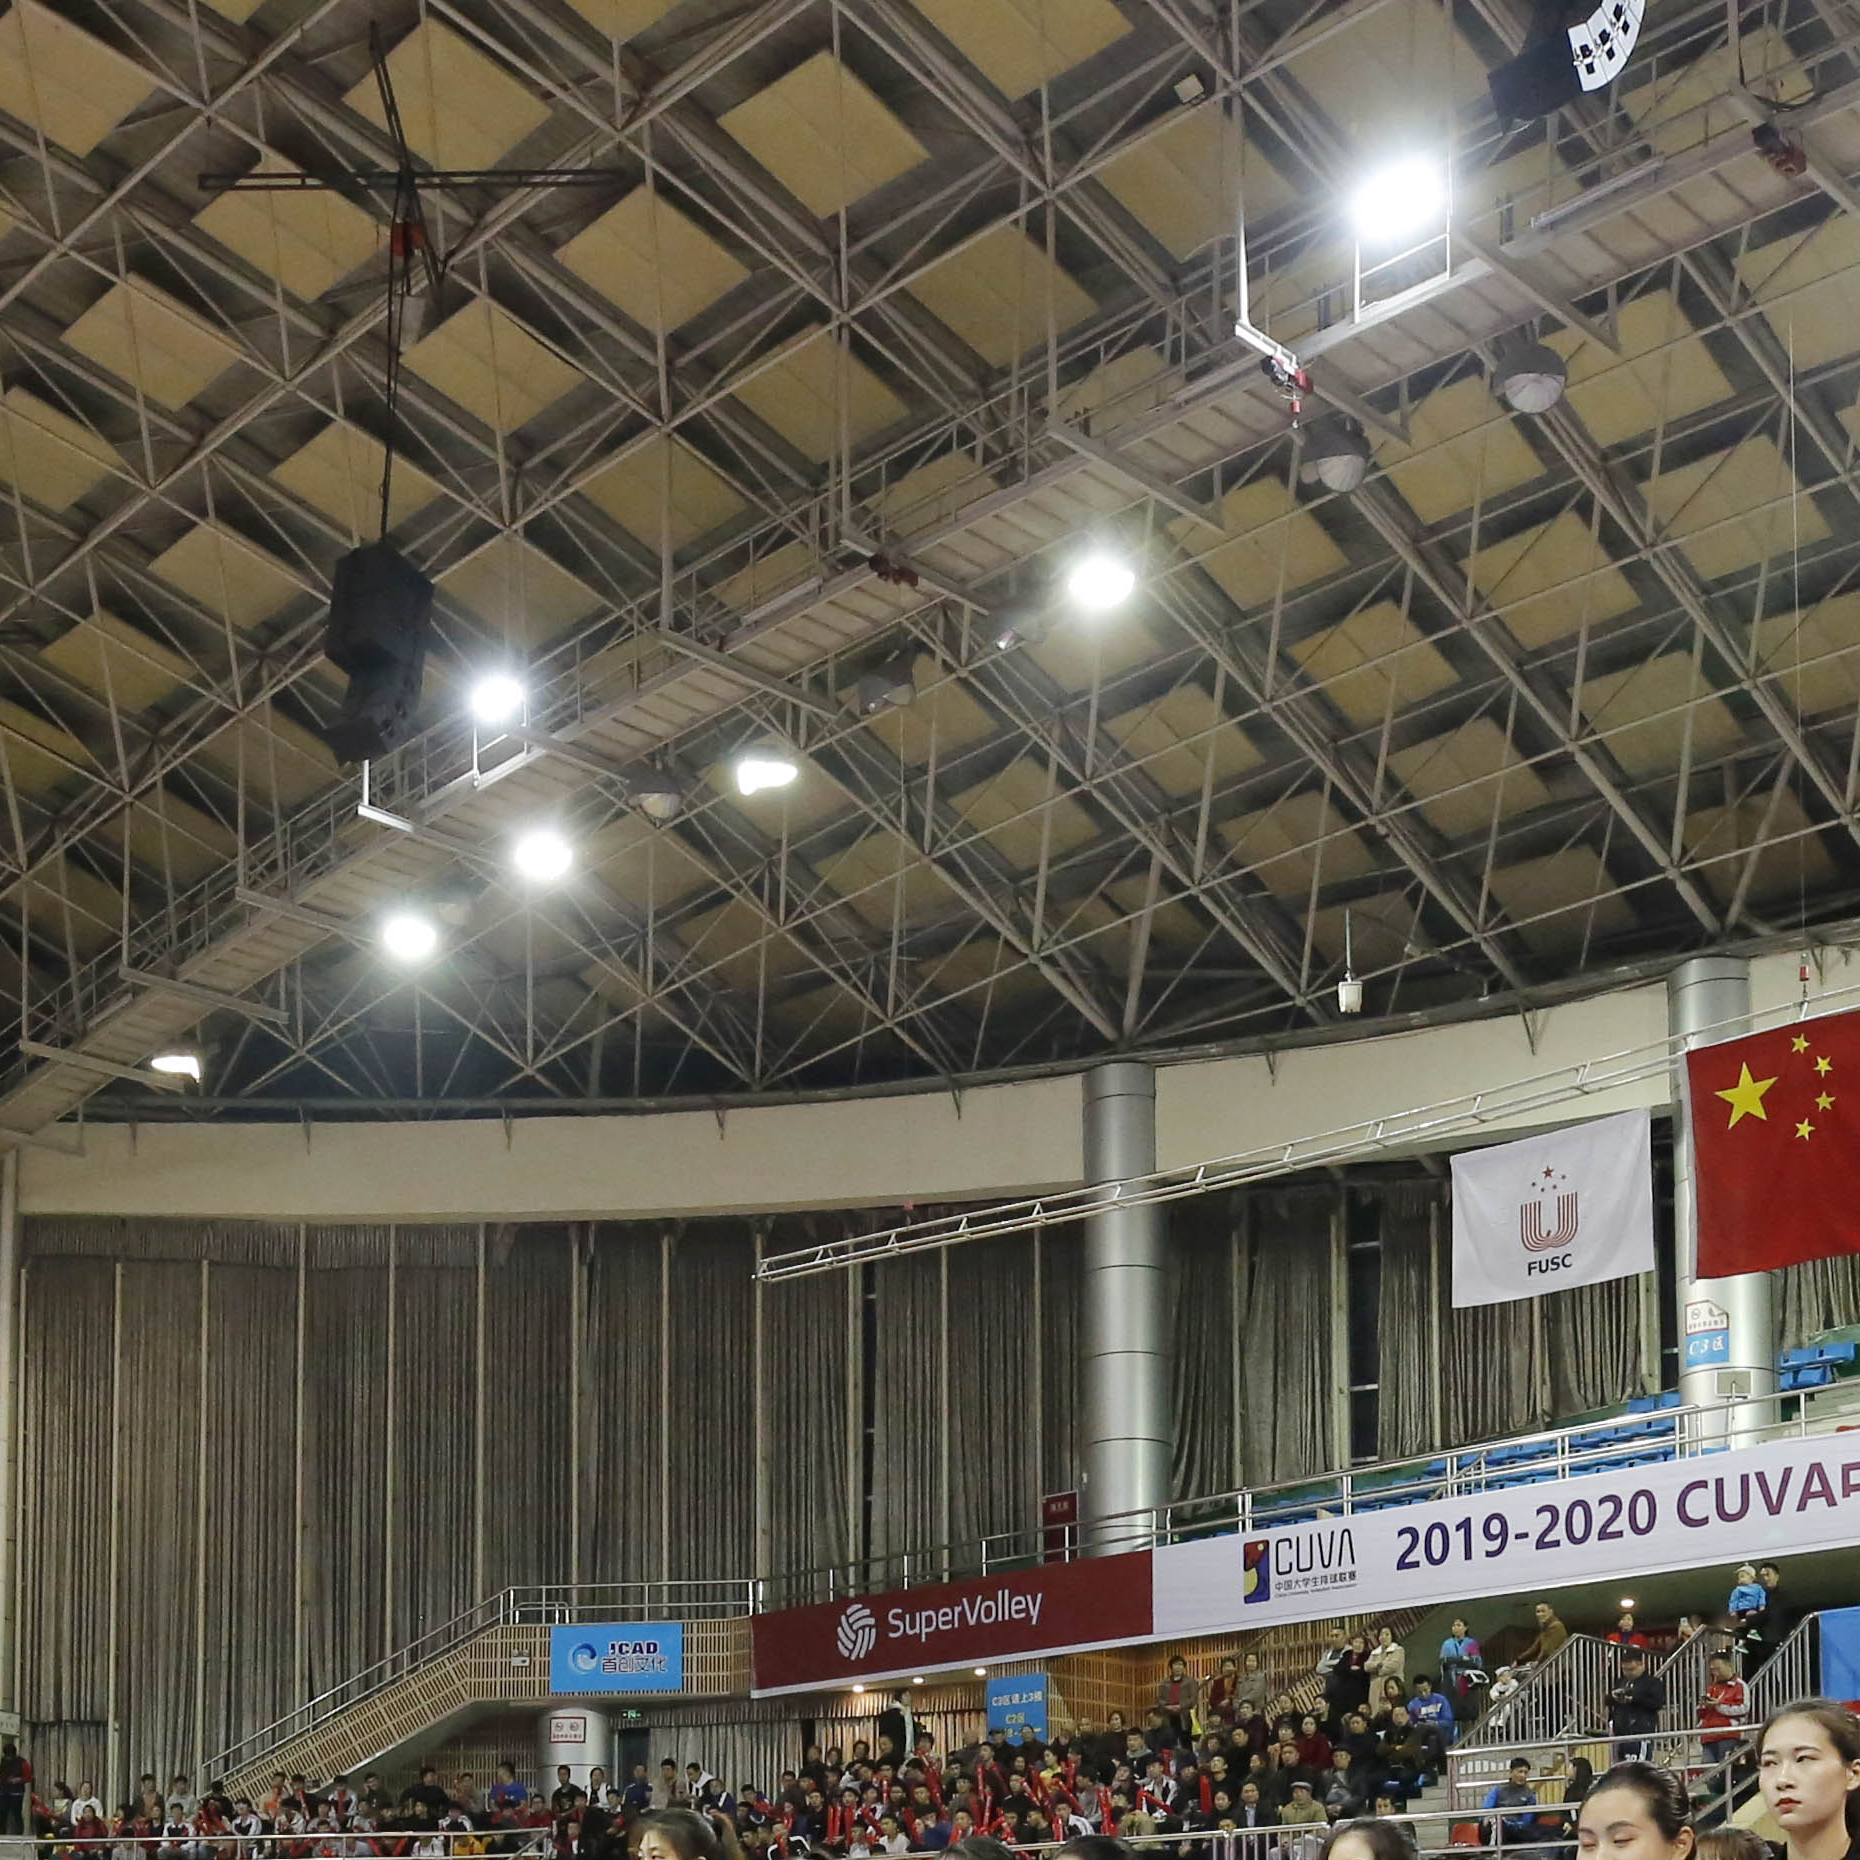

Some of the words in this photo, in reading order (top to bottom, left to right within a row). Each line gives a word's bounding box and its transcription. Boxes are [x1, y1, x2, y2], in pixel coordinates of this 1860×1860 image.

[1526, 1253, 1573, 1277] FUSC
[1396, 1488, 1656, 1572] 2019-2020
[1275, 1528, 1355, 1576] CUVA
[1275, 1570, 1357, 1591] 中国大学生排球联赛
[887, 1590, 1042, 1643] SuperVolley
[602, 1656, 667, 1673] 首创文化
